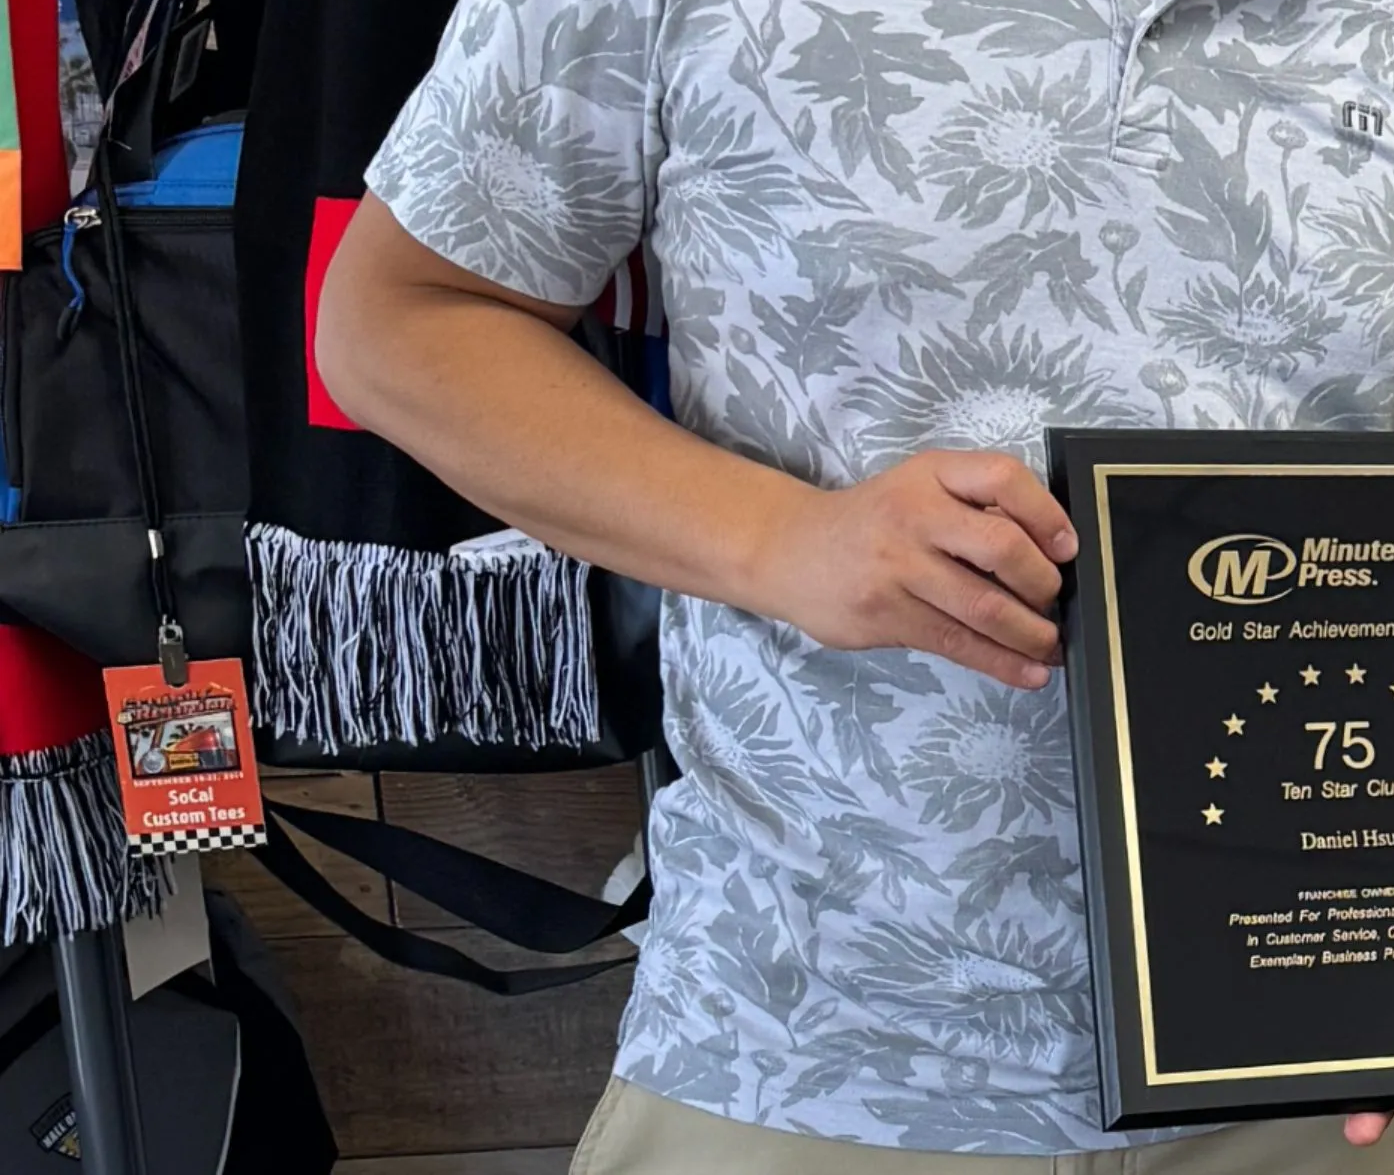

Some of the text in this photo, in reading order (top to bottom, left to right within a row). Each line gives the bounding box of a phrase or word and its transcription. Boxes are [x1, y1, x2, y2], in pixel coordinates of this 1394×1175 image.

[1298, 563, 1379, 587] Press.
[1189, 622, 1232, 641] Gold
[1243, 622, 1281, 640] Star
[1304, 720, 1376, 770] 75
[168, 786, 214, 806] SoCal
[1280, 781, 1313, 800] Ten
[1320, 780, 1359, 799] Star
[143, 806, 246, 827] Custom Tees
[1300, 830, 1358, 851] Daniel
[1229, 911, 1293, 926] Presented
[1299, 909, 1321, 923] For
[1266, 932, 1326, 946] Customer
[1250, 953, 1316, 969] Exemplary
[1322, 950, 1378, 965] Business
